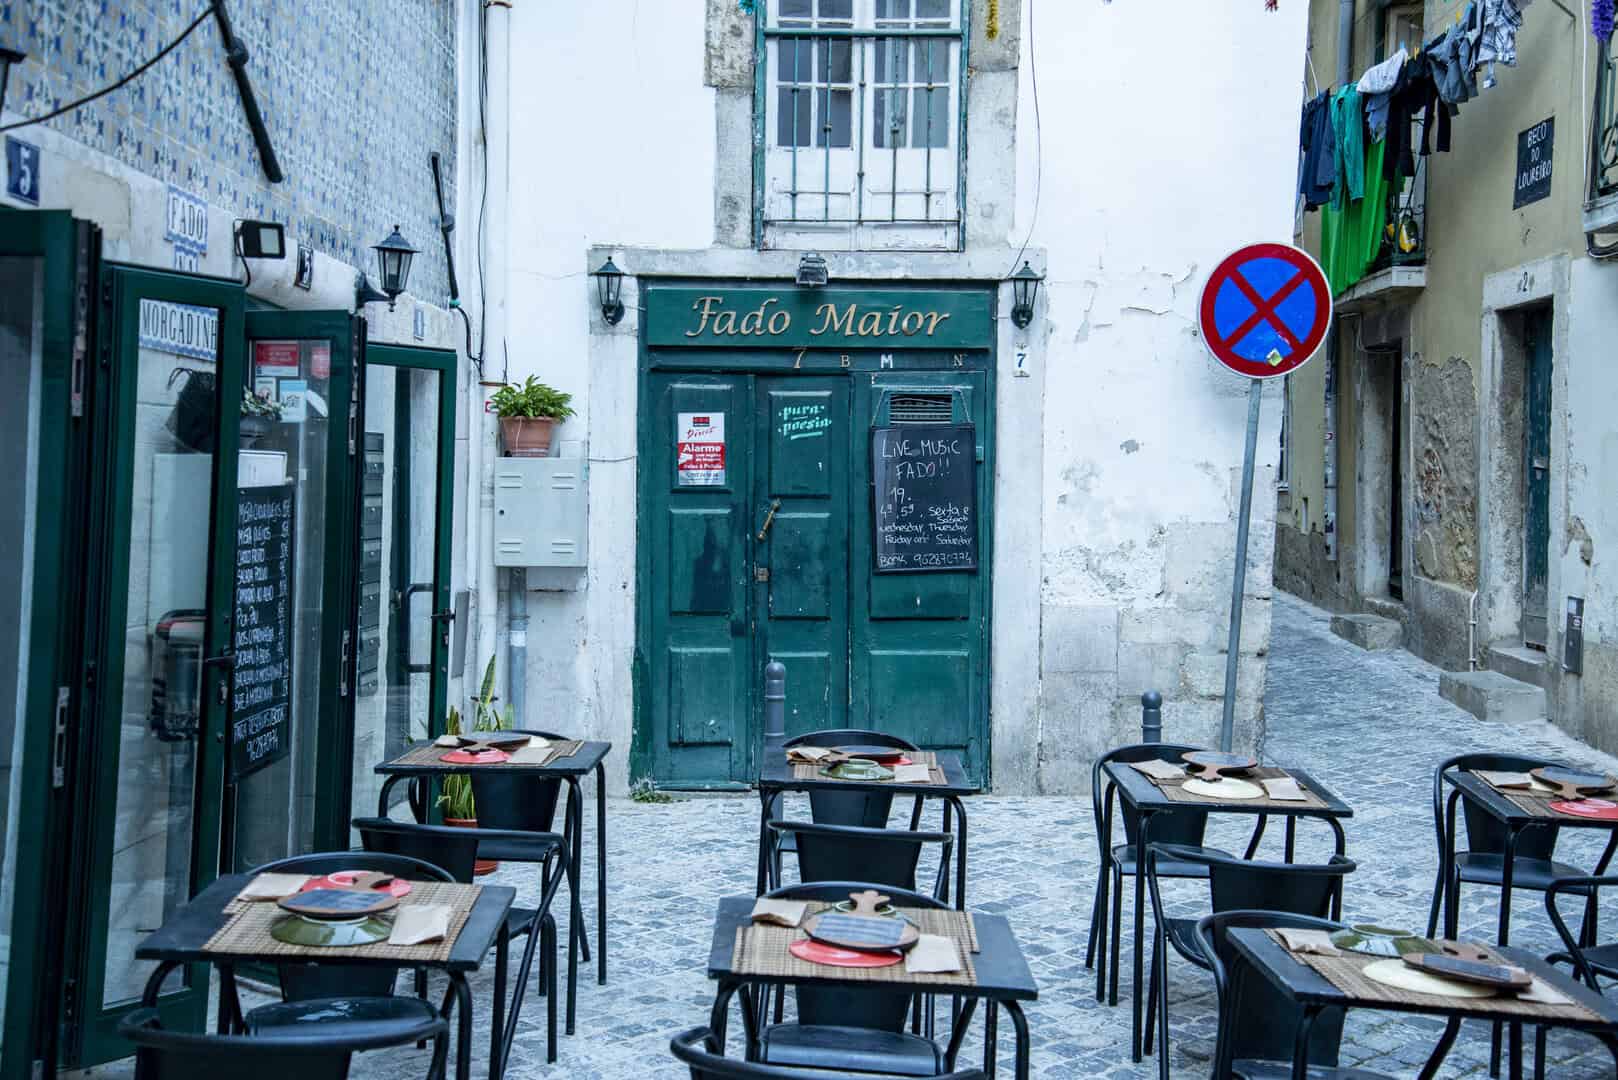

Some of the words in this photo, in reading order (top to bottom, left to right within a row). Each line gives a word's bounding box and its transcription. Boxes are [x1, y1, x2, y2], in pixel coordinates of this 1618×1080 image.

[1527, 122, 1547, 148] BECO
[1530, 146, 1541, 163] DO
[19, 146, 32, 195] 5
[1518, 159, 1552, 190] LOUREIRO
[170, 196, 205, 241] FADO
[142, 301, 217, 351] MORGADINH
[684, 296, 791, 337] Fado
[809, 303, 950, 336] Maior
[792, 345, 808, 368] 7
[840, 354, 850, 368] B
[880, 353, 893, 369] M
[1016, 353, 1026, 368] 7
[682, 443, 721, 453] Alarme
